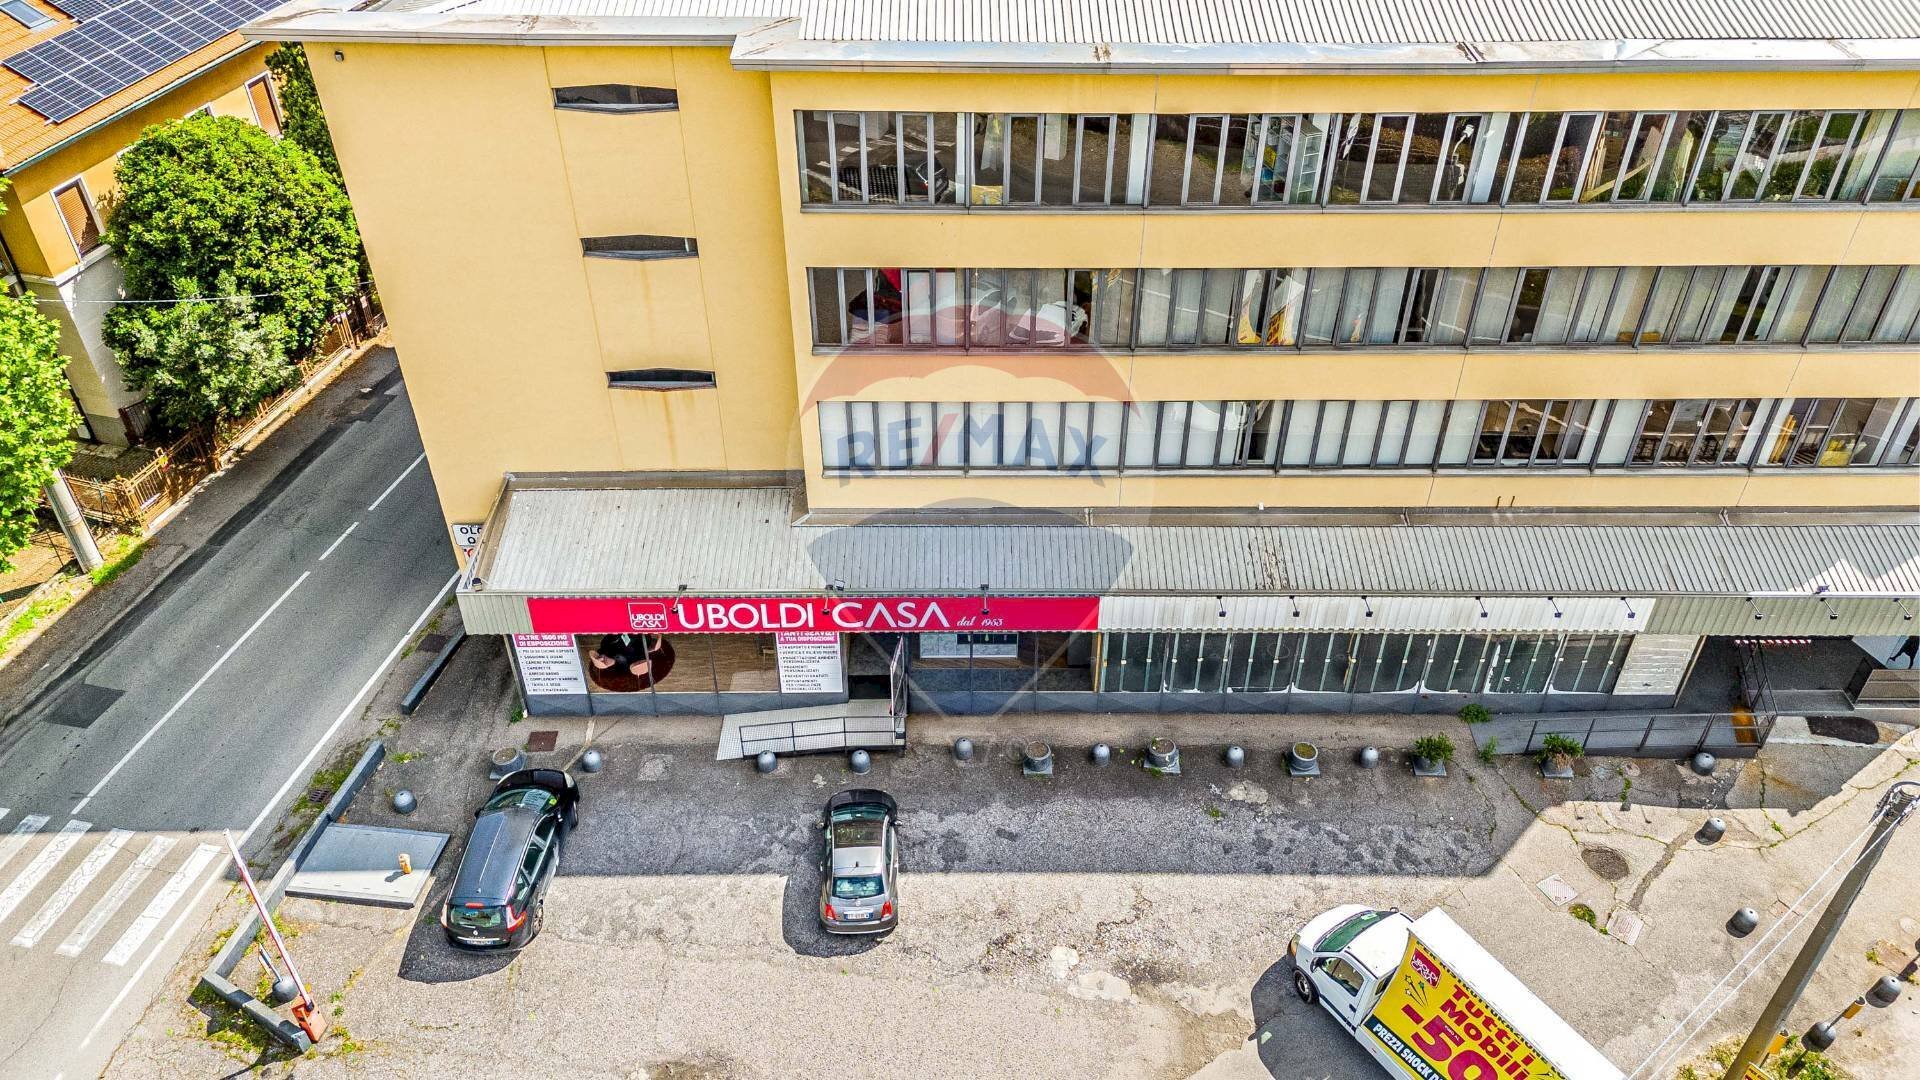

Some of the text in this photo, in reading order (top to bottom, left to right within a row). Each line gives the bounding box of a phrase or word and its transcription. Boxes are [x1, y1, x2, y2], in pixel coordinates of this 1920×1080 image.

[631, 613, 665, 621] UBOLDI
[633, 620, 662, 628] CASA
[677, 601, 950, 629] UBOLDI CASA
[956, 616, 976, 627] dal
[1452, 983, 1536, 1067] Tutti i
[1372, 1023, 1405, 1054] PREZZI
[1401, 1048, 1433, 1079] SHOCK
[1439, 999, 1531, 1080] Mobili
